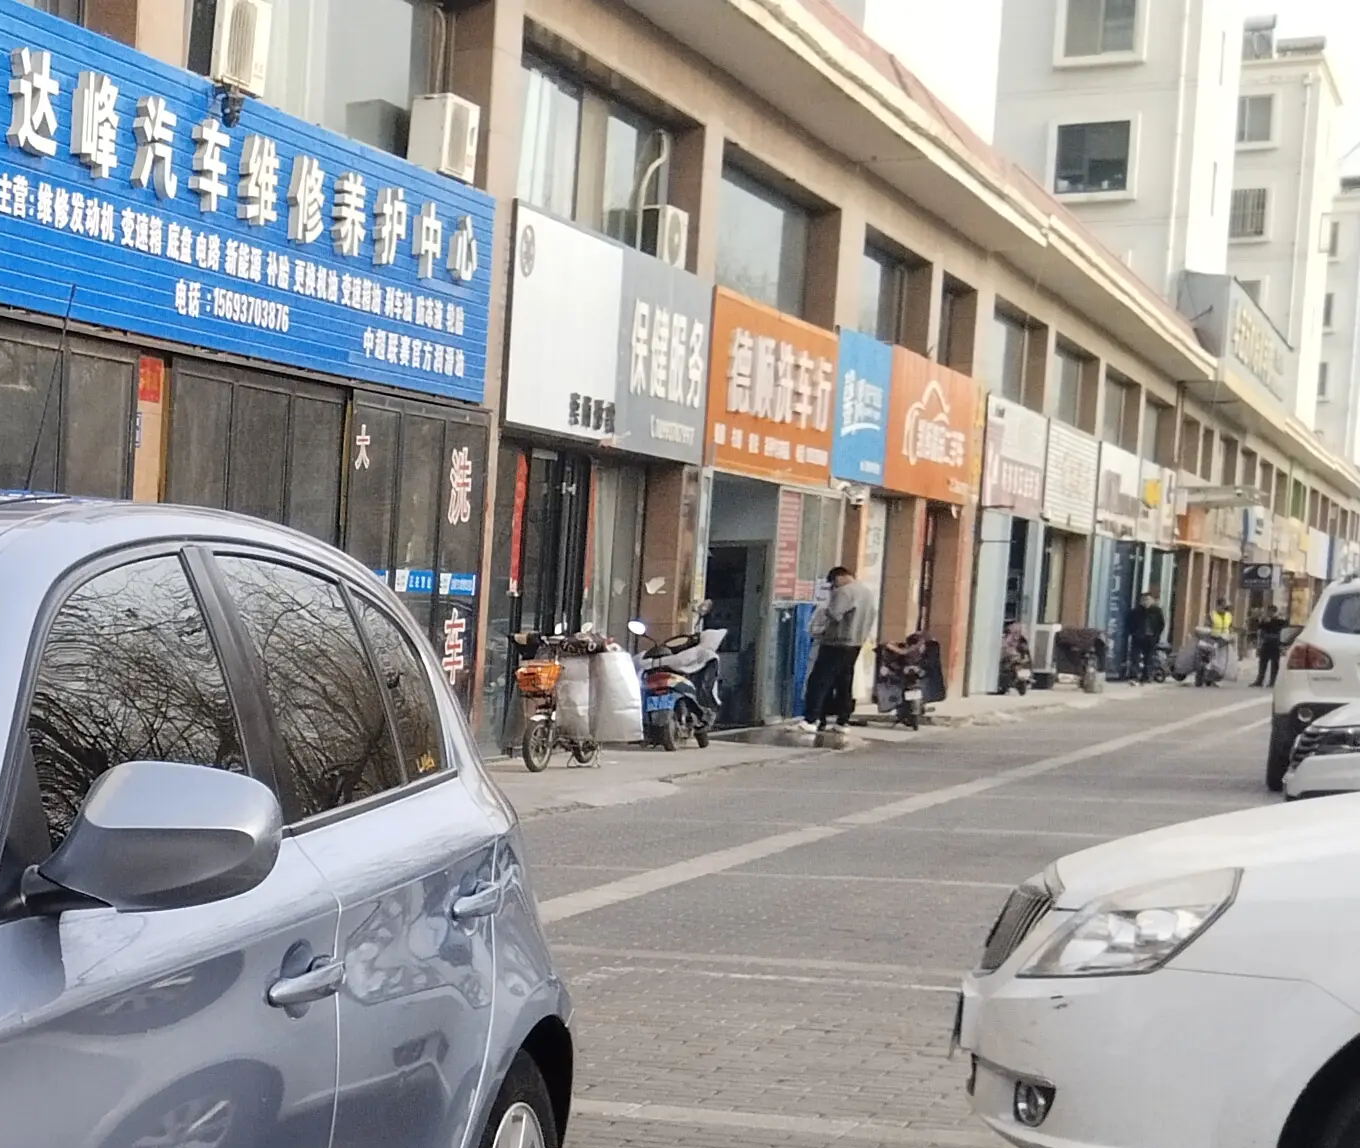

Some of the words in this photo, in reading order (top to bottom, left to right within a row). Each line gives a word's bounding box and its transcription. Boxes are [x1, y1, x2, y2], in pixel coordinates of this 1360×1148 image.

[6, 47, 478, 282] 达峰汽车维修养护中心
[121, 208, 163, 255] 变速箱
[167, 221, 192, 264] 底盘
[196, 232, 220, 271] 电路
[224, 238, 262, 283] 新能源
[267, 251, 290, 289] 补胎
[630, 297, 704, 409] 保健服务
